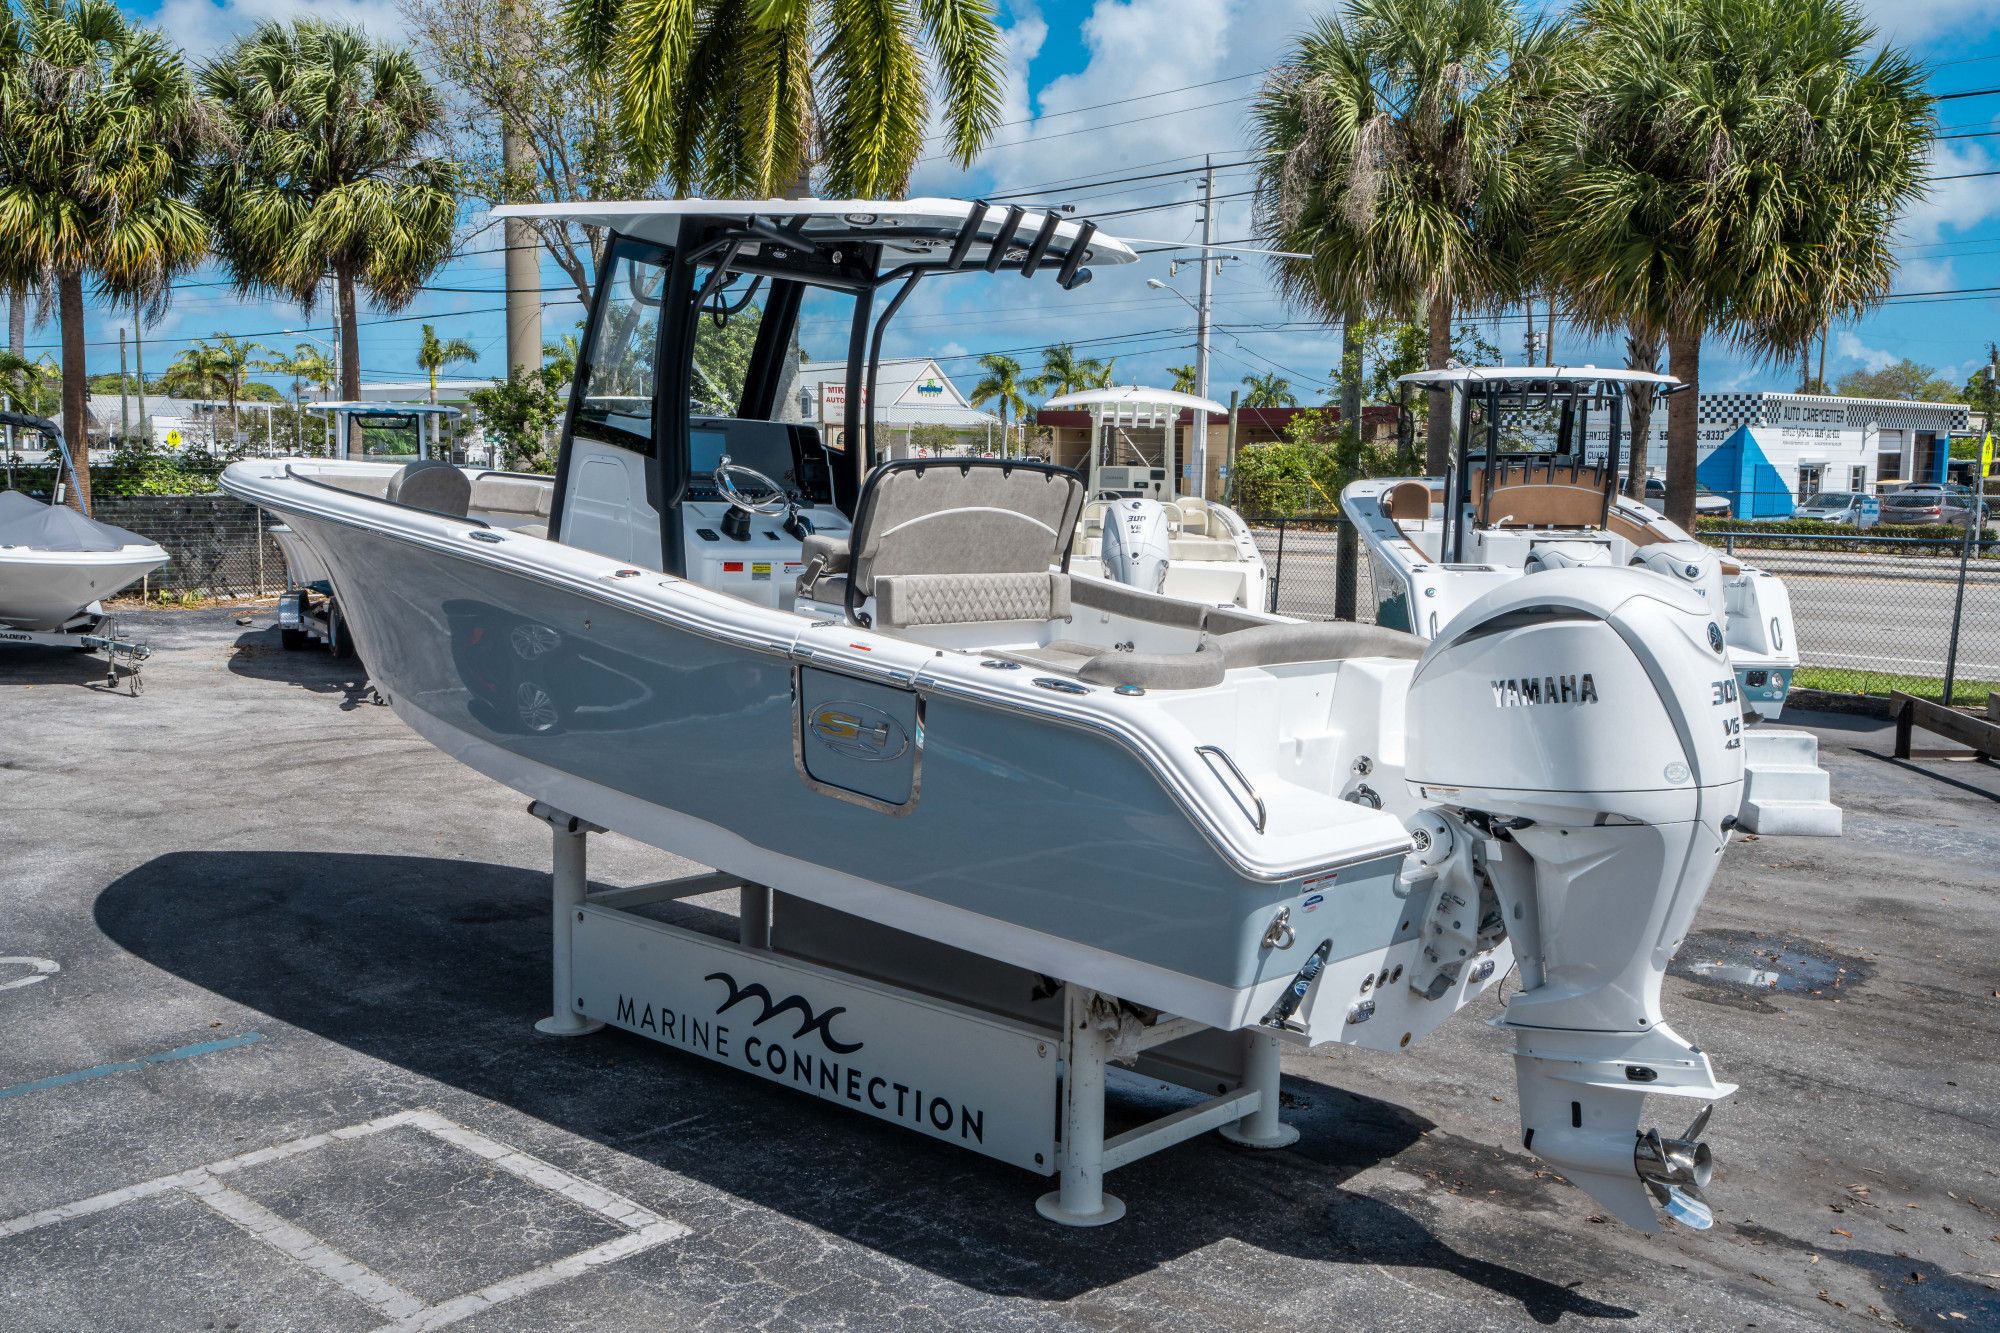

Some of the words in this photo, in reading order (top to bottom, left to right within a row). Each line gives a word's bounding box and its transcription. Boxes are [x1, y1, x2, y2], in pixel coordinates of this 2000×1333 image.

[1784, 406, 1800, 420] AUTO
[1803, 407, 1819, 422] CARE
[1822, 409, 1845, 424] CENTER
[1490, 673, 1599, 708] YAMAHA
[616, 993, 730, 1058] MARINE
[744, 1036, 984, 1145] CONNECTION
